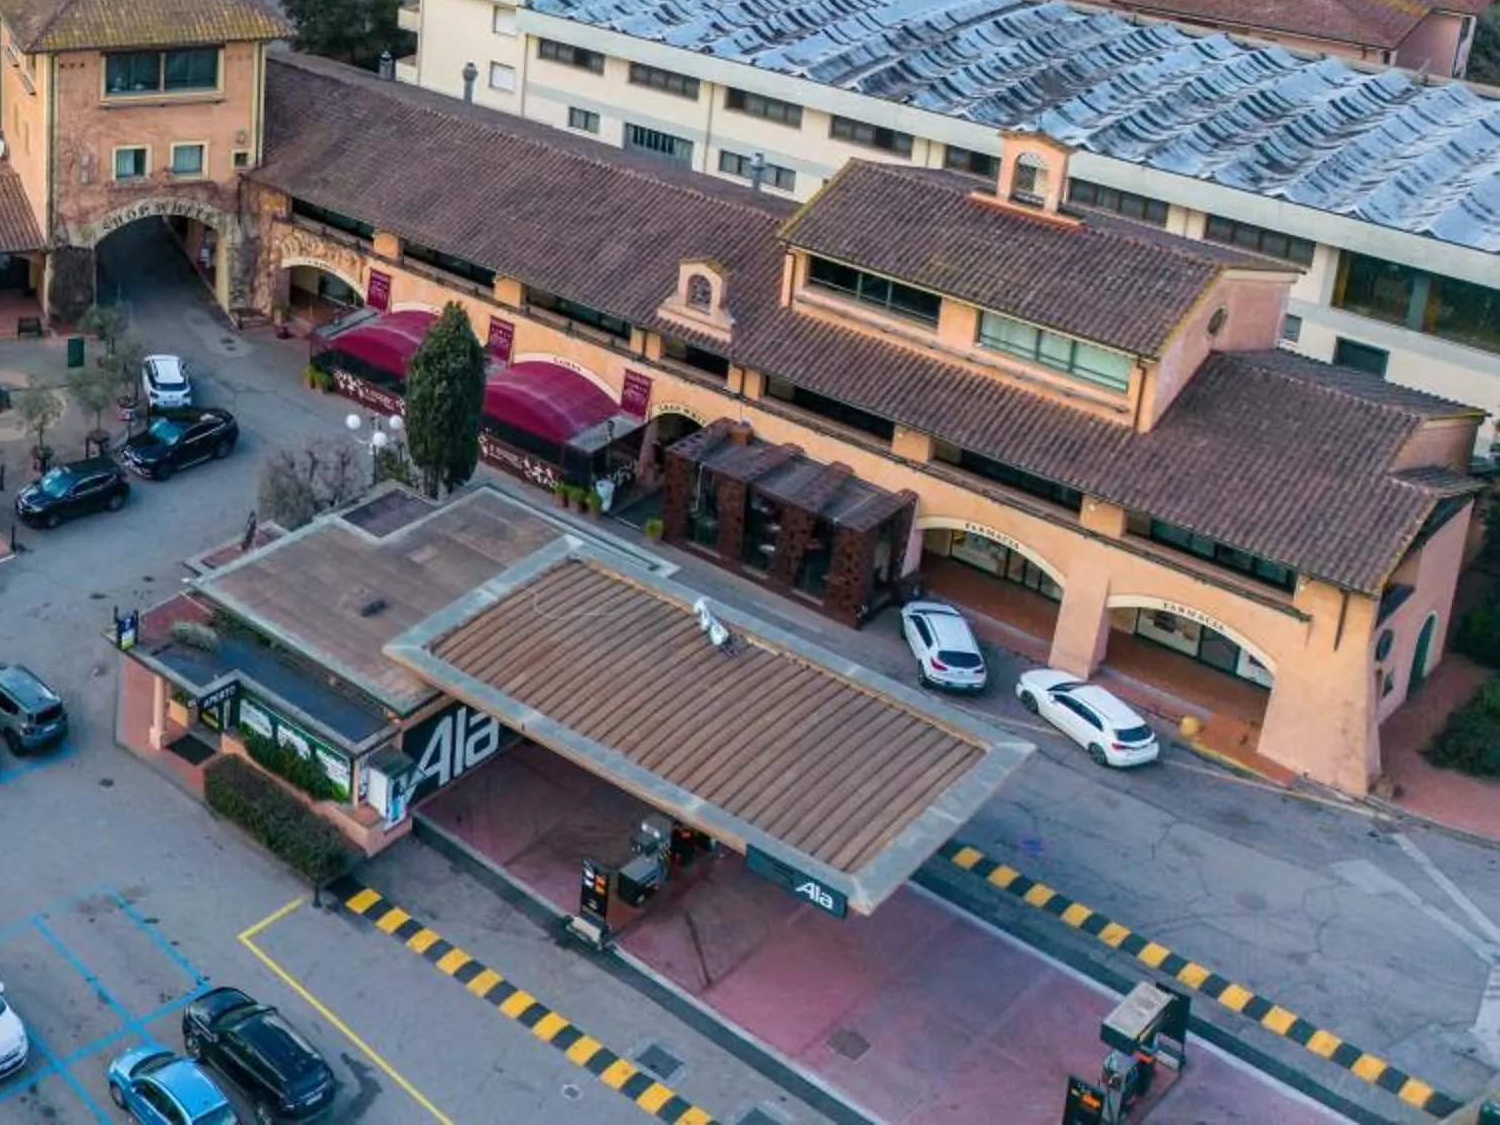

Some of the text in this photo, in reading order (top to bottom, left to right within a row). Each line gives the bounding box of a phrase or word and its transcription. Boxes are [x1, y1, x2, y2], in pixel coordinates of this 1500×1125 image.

[965, 522, 1020, 550] FARMACIA
[1163, 601, 1224, 630] FARMACIA
[795, 882, 834, 910] Ala
